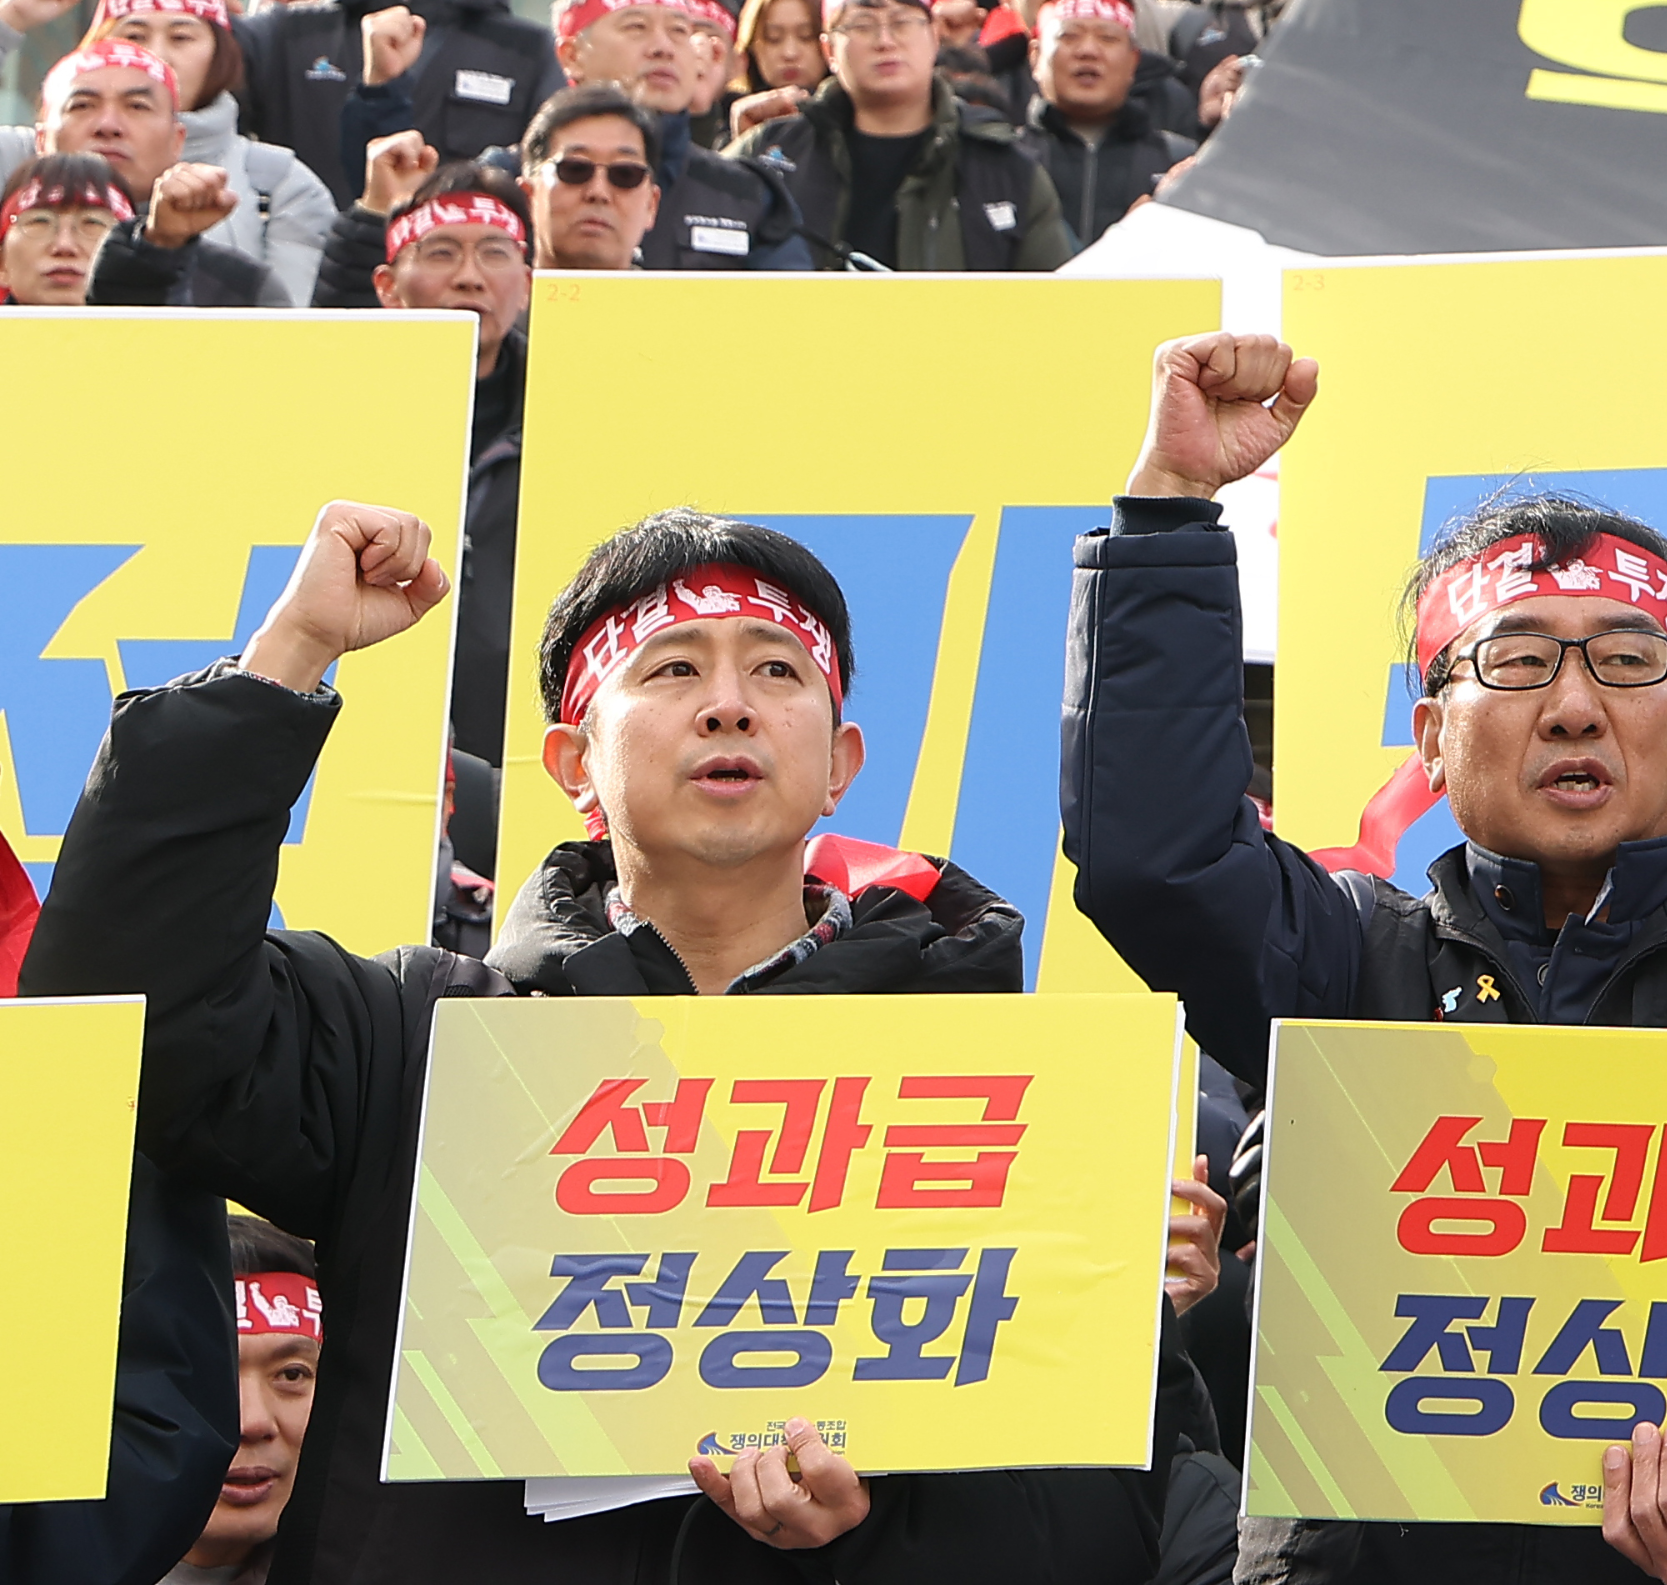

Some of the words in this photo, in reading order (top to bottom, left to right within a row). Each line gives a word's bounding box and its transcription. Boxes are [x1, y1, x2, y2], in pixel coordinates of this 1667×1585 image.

[583, 580, 676, 681] 단결
[748, 577, 833, 674] 투쟁
[1447, 541, 1538, 619] 단결
[549, 1073, 1035, 1216] 성과급
[534, 1246, 1019, 1392] 정상화
[767, 1420, 847, 1432] 전국동조합
